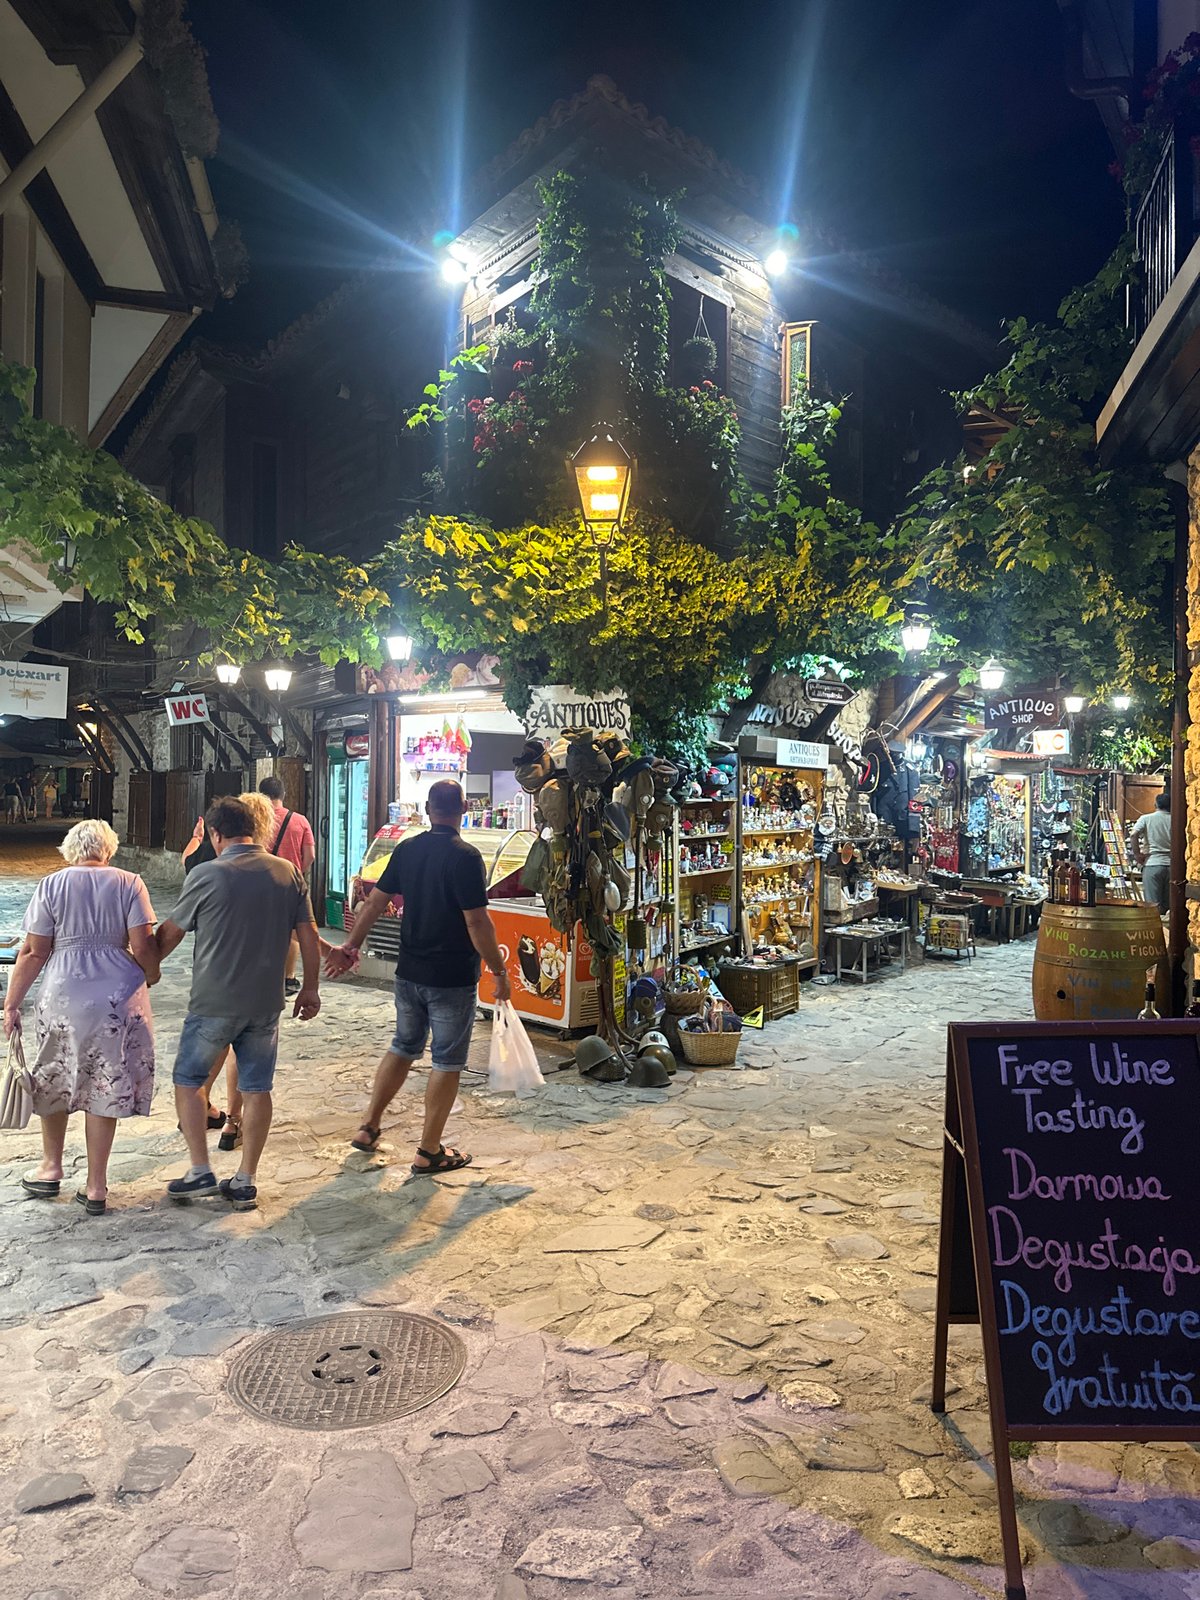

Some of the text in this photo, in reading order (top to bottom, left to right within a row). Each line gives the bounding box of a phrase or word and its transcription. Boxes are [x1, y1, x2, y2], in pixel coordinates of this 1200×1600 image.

[171, 699, 206, 720] WC
[530, 698, 626, 730] ANTIQUES
[747, 700, 862, 761] NTIQUES SHOP
[989, 698, 1055, 720] ANTIQUE
[1011, 713, 1034, 724] SHOP
[789, 742, 821, 757] ANTIQUES
[998, 1042, 1175, 1086] Free Wine
[1011, 1088, 1146, 1155] Tasting
[1002, 1147, 1172, 1201] Darmowa
[988, 1205, 1200, 1296] Degustacja
[1000, 1280, 1200, 1367] Degustare
